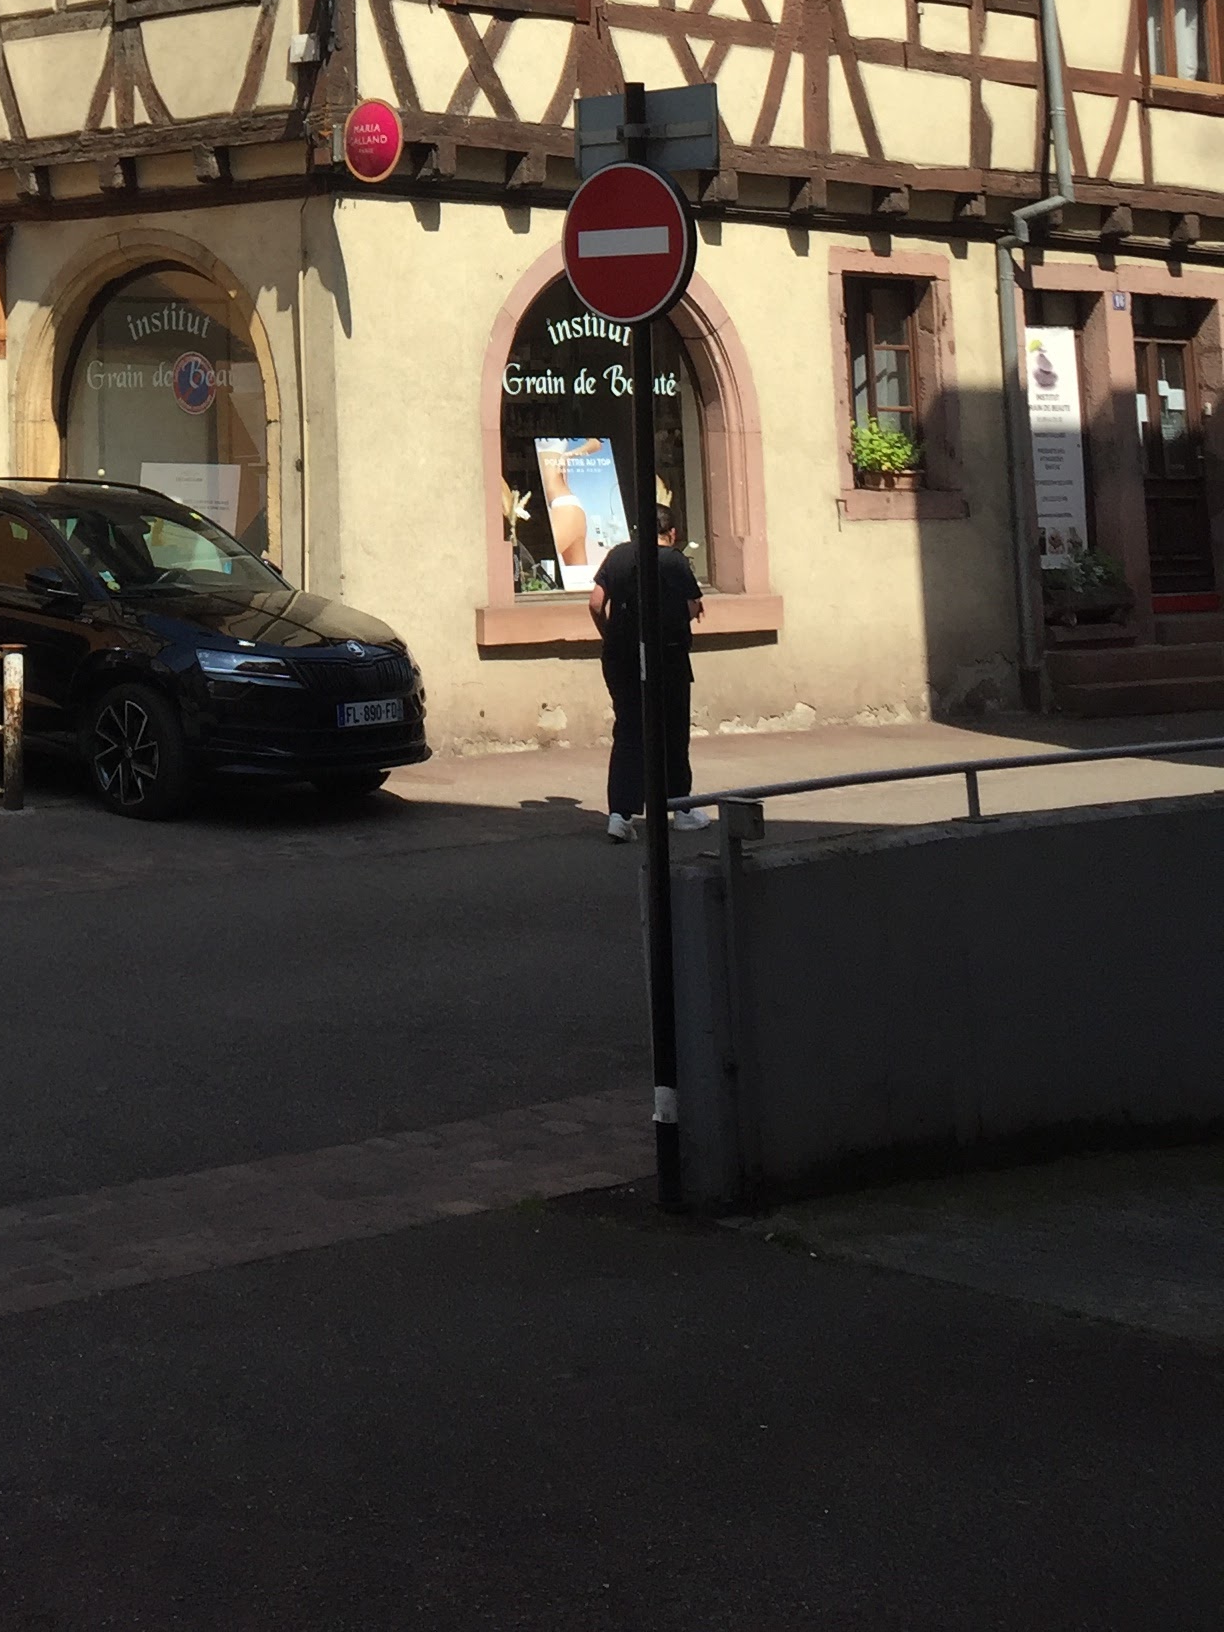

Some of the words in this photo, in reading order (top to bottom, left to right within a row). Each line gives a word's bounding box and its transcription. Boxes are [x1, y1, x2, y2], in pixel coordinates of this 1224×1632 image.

[354, 123, 381, 134] MARIA
[127, 303, 211, 341] institut
[545, 312, 633, 347] institut
[86, 360, 144, 390] Grain
[152, 361, 174, 388] de
[502, 363, 566, 395] Grain
[573, 368, 596, 395] de
[602, 364, 678, 397] Beuté
[598, 458, 611, 467] TOP
[346, 702, 397, 723] FL-890-FD
